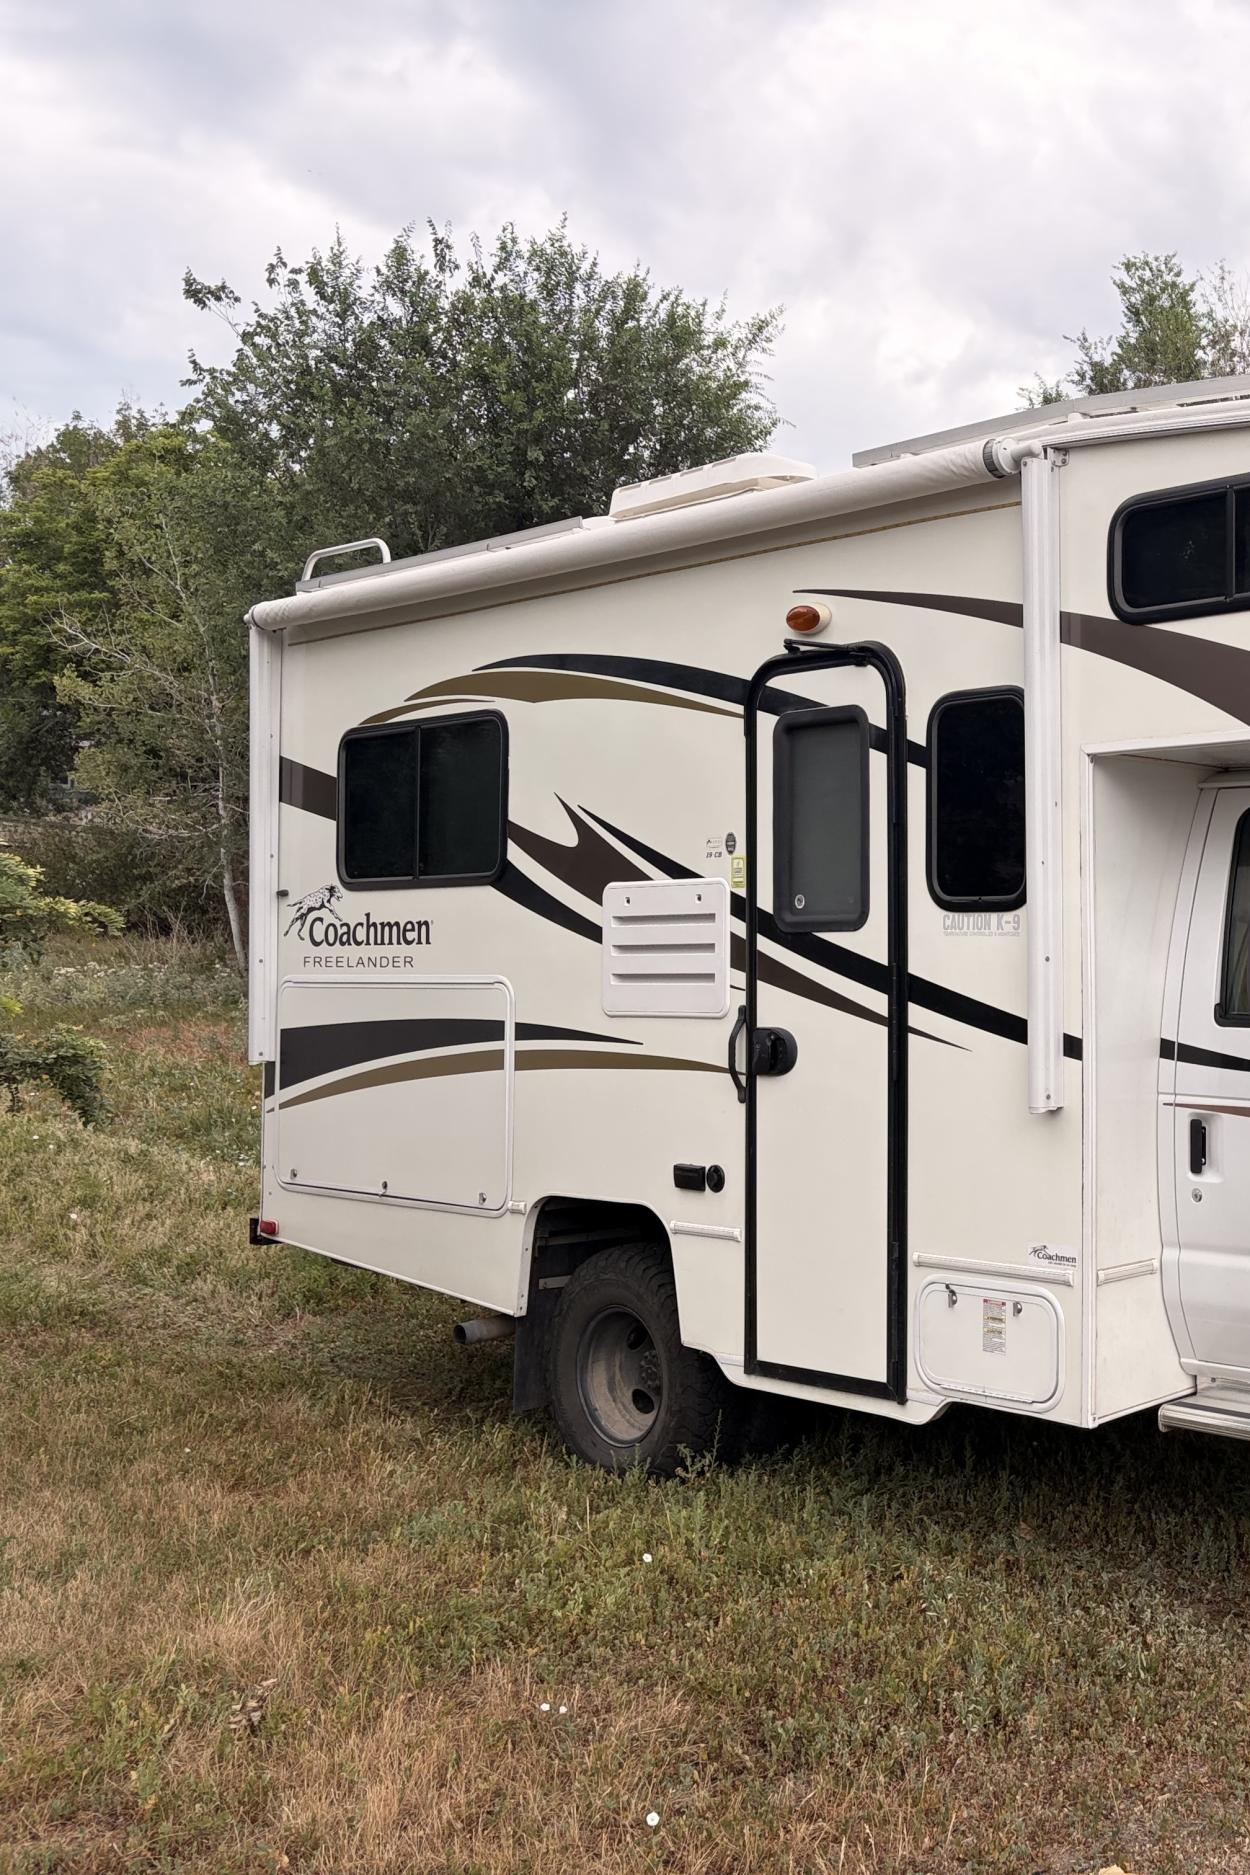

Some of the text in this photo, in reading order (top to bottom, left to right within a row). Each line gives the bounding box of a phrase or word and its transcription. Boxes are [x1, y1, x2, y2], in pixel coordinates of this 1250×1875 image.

[309, 912, 431, 946] Coachmen
[943, 913, 1021, 931] CAUTION K-9
[303, 955, 414, 968] FREELANDER
[1036, 1251, 1077, 1264] Coachmen
